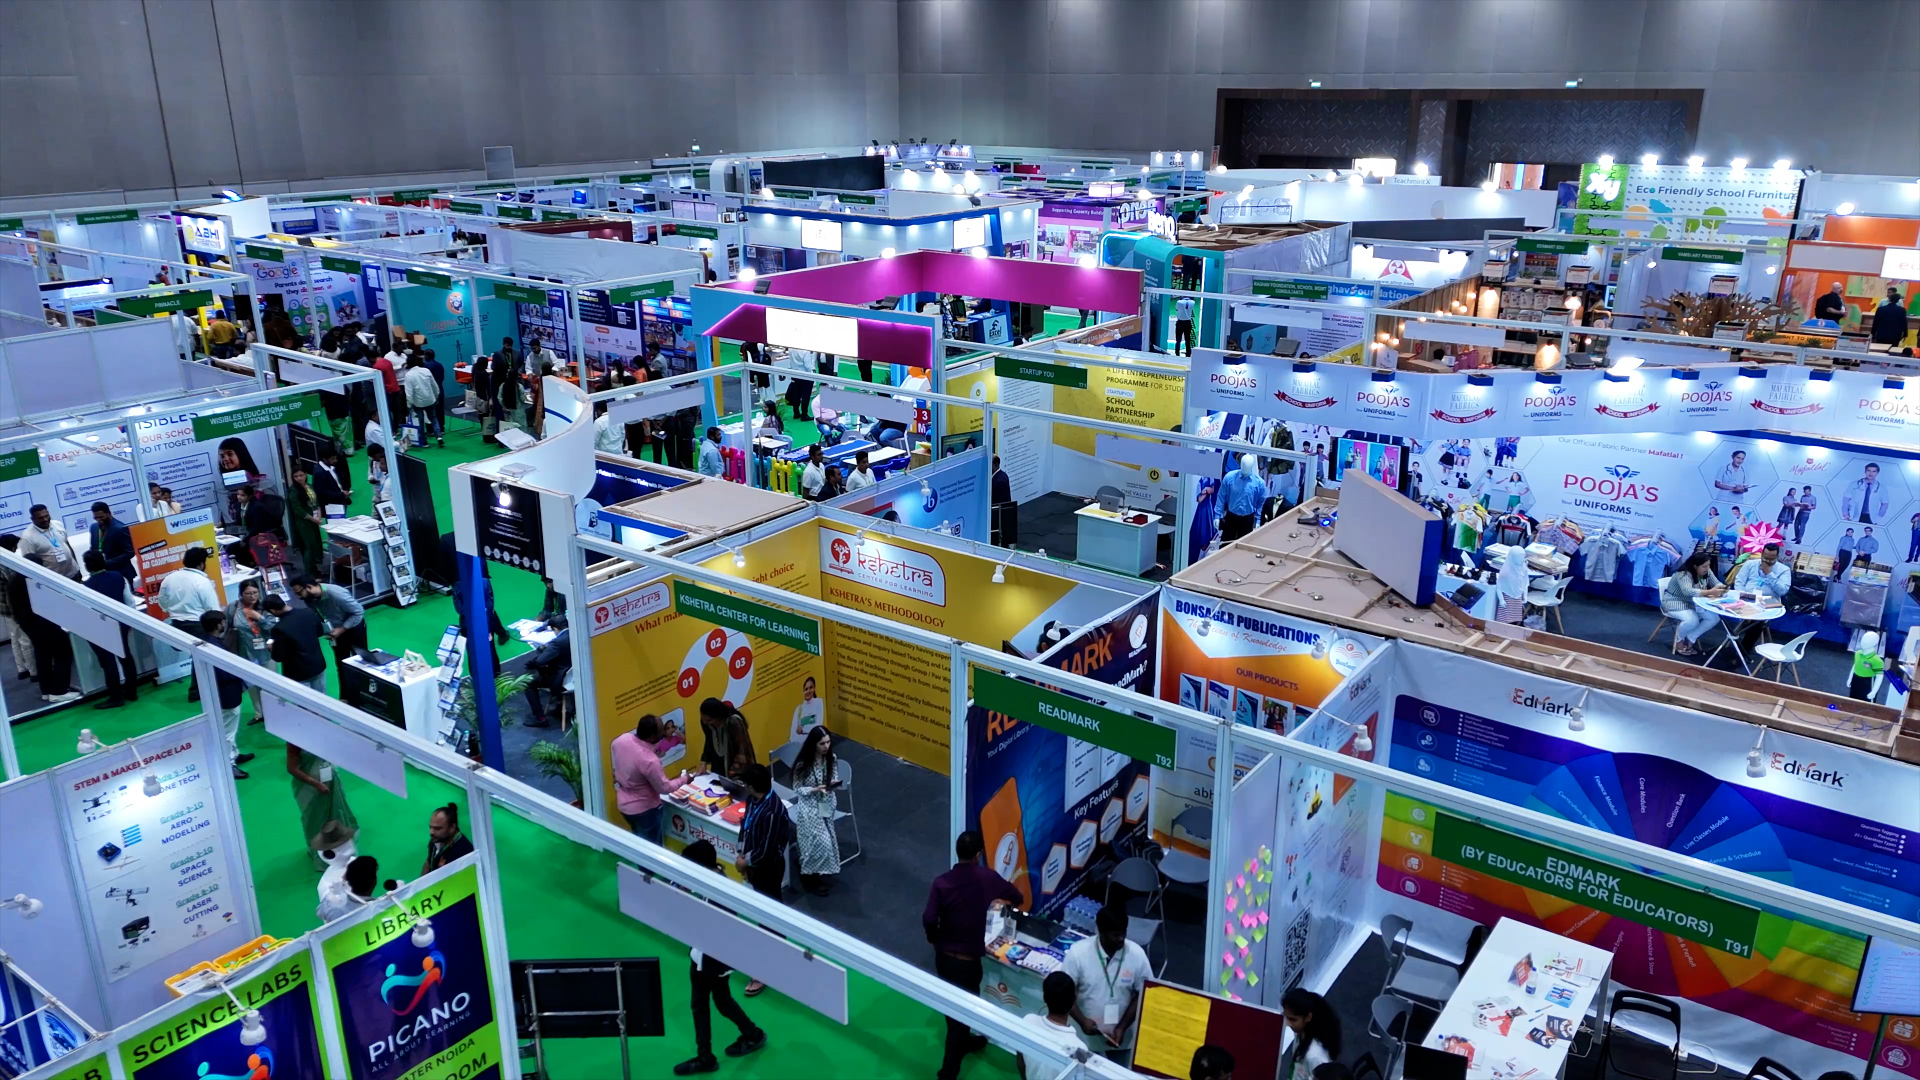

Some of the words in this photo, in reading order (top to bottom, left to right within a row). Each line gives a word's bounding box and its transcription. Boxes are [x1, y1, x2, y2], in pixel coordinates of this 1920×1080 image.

[1636, 186, 1654, 195] Eco
[1658, 187, 1703, 201] Friendly
[1706, 189, 1745, 199] School
[194, 227, 218, 238] ABHI
[256, 264, 298, 280] Google
[275, 280, 296, 289] Parents
[314, 277, 332, 285] search
[286, 288, 299, 296] they
[154, 298, 180, 309] PINNACLE
[1019, 367, 1042, 378] STARTUP
[1043, 369, 1054, 378] YOU
[1112, 367, 1125, 376] LIFE
[1106, 376, 1148, 388] PROGRAMME
[1150, 381, 1163, 391] FOR
[1216, 388, 1244, 398] UNIFORMS
[1284, 395, 1303, 406] SCHOOL
[1356, 391, 1410, 408] POOJA'S
[1680, 391, 1733, 405] POOJA'S
[1106, 397, 1134, 408] SCHOOL
[1524, 394, 1576, 410] POOJA'S
[1686, 405, 1718, 415] UNIFORMS
[1761, 402, 1782, 413] SCHOOL
[209, 412, 236, 425] WISIBLES
[238, 404, 283, 421] EDUCATIONAL
[284, 401, 302, 412] ERP
[310, 409, 322, 419] E29
[1105, 414, 1146, 426] PROGRAMME
[1106, 405, 1154, 419] PARTNERSHIP
[1362, 407, 1395, 418] UNIFORMS
[1441, 411, 1461, 423] SCHOOL
[1462, 411, 1485, 423] UNIFORM
[1530, 409, 1562, 418] UNIFORMS
[1606, 406, 1626, 418] SCHOOL
[1627, 405, 1650, 418] UNIFORM
[1865, 414, 1905, 425] UNIFORMS
[232, 416, 267, 429] SOLUTIONS
[268, 412, 283, 422] LLP
[153, 445, 162, 454] IT
[1558, 435, 1571, 445] Our
[1572, 437, 1597, 448] Official
[1598, 440, 1617, 451] Fabric
[1618, 444, 1646, 455] Partner
[1648, 448, 1679, 459] Mafatlal
[26, 466, 39, 477] E29
[1562, 474, 1659, 504] POOJA'S
[1574, 498, 1631, 515] UNIFORMS
[170, 513, 208, 529] WISIBLES
[768, 562, 795, 581] choice
[856, 547, 933, 588] kshetra
[857, 572, 882, 584] CENTER
[884, 579, 898, 589] FOR
[899, 583, 934, 599] LEARNING
[611, 590, 661, 620] kshetra
[829, 586, 872, 608] KSHETRA'S
[873, 600, 945, 628] METHODOLOGY
[635, 615, 662, 635] What
[679, 593, 715, 615] KSHETRA
[716, 605, 749, 627] CENTER
[749, 615, 767, 633] FOR
[767, 620, 810, 647] LEARNING
[1175, 599, 1235, 626] BONSAGAR
[1236, 614, 1321, 648] PUBLICATIONS
[709, 637, 722, 649] 02
[805, 641, 819, 656] T93
[915, 646, 933, 656] having
[1230, 630, 1241, 641] of
[1243, 631, 1287, 657] Knowledge
[734, 656, 747, 669] 03
[868, 651, 888, 665] learning
[889, 657, 912, 671] through
[911, 665, 927, 676] Group
[890, 647, 906, 657] based
[906, 653, 929, 666] Teaching
[836, 652, 845, 660] The
[864, 661, 886, 675] teaching
[931, 683, 948, 694] simple
[1236, 667, 1254, 680] OUR
[1254, 672, 1299, 694] PRODUCTS
[680, 676, 694, 690] 01
[877, 683, 905, 698] conceptual
[921, 699, 944, 712] followed
[1511, 687, 1573, 717] EdMark
[1038, 701, 1100, 734] READMARK
[899, 726, 916, 739] Group
[986, 747, 999, 759] Your
[998, 738, 1013, 753] Digital
[73, 777, 101, 792] STEM
[101, 772, 110, 781] &
[143, 747, 173, 767] SPACE
[173, 741, 192, 756] LAB
[1155, 752, 1171, 768] T92
[1770, 751, 1844, 787] EdMark
[178, 771, 200, 788] TECH
[1638, 776, 1647, 790] Core
[1073, 804, 1089, 821] Key
[1088, 779, 1119, 807] Features
[1593, 774, 1607, 796] Finance
[1605, 795, 1618, 816] Module
[1639, 791, 1647, 814] Modules
[1666, 804, 1680, 828] Question
[1677, 792, 1687, 806] Bank
[169, 816, 192, 831] AERO
[1682, 837, 1695, 850] Live
[1694, 827, 1712, 843] Classes
[1711, 814, 1729, 831] Module
[160, 819, 210, 846] MODELLING
[169, 855, 195, 871] Grade
[195, 845, 214, 859] 3-10
[1733, 849, 1762, 863] Schedule
[179, 858, 206, 876] SPACE
[1545, 855, 1621, 892] EDMARK
[177, 866, 213, 888] SCIENCE
[1459, 843, 1485, 862] (BY
[1486, 853, 1574, 892] EDUCATORS
[1576, 880, 1609, 903] FOR
[1611, 890, 1714, 939] EDUCATORS)
[185, 896, 212, 914] LASER
[182, 903, 219, 925] CUTTING
[363, 889, 444, 947] LIBRARY
[1723, 937, 1750, 958] T91
[131, 998, 241, 1065] SCIENCE
[247, 963, 302, 1008] LABS
[367, 992, 471, 1064] PICANO
[371, 1060, 389, 1076] ALL
[392, 1039, 422, 1062] ABOUT
[424, 1010, 471, 1041] LEARNING
[434, 1038, 476, 1069] NOIDA
